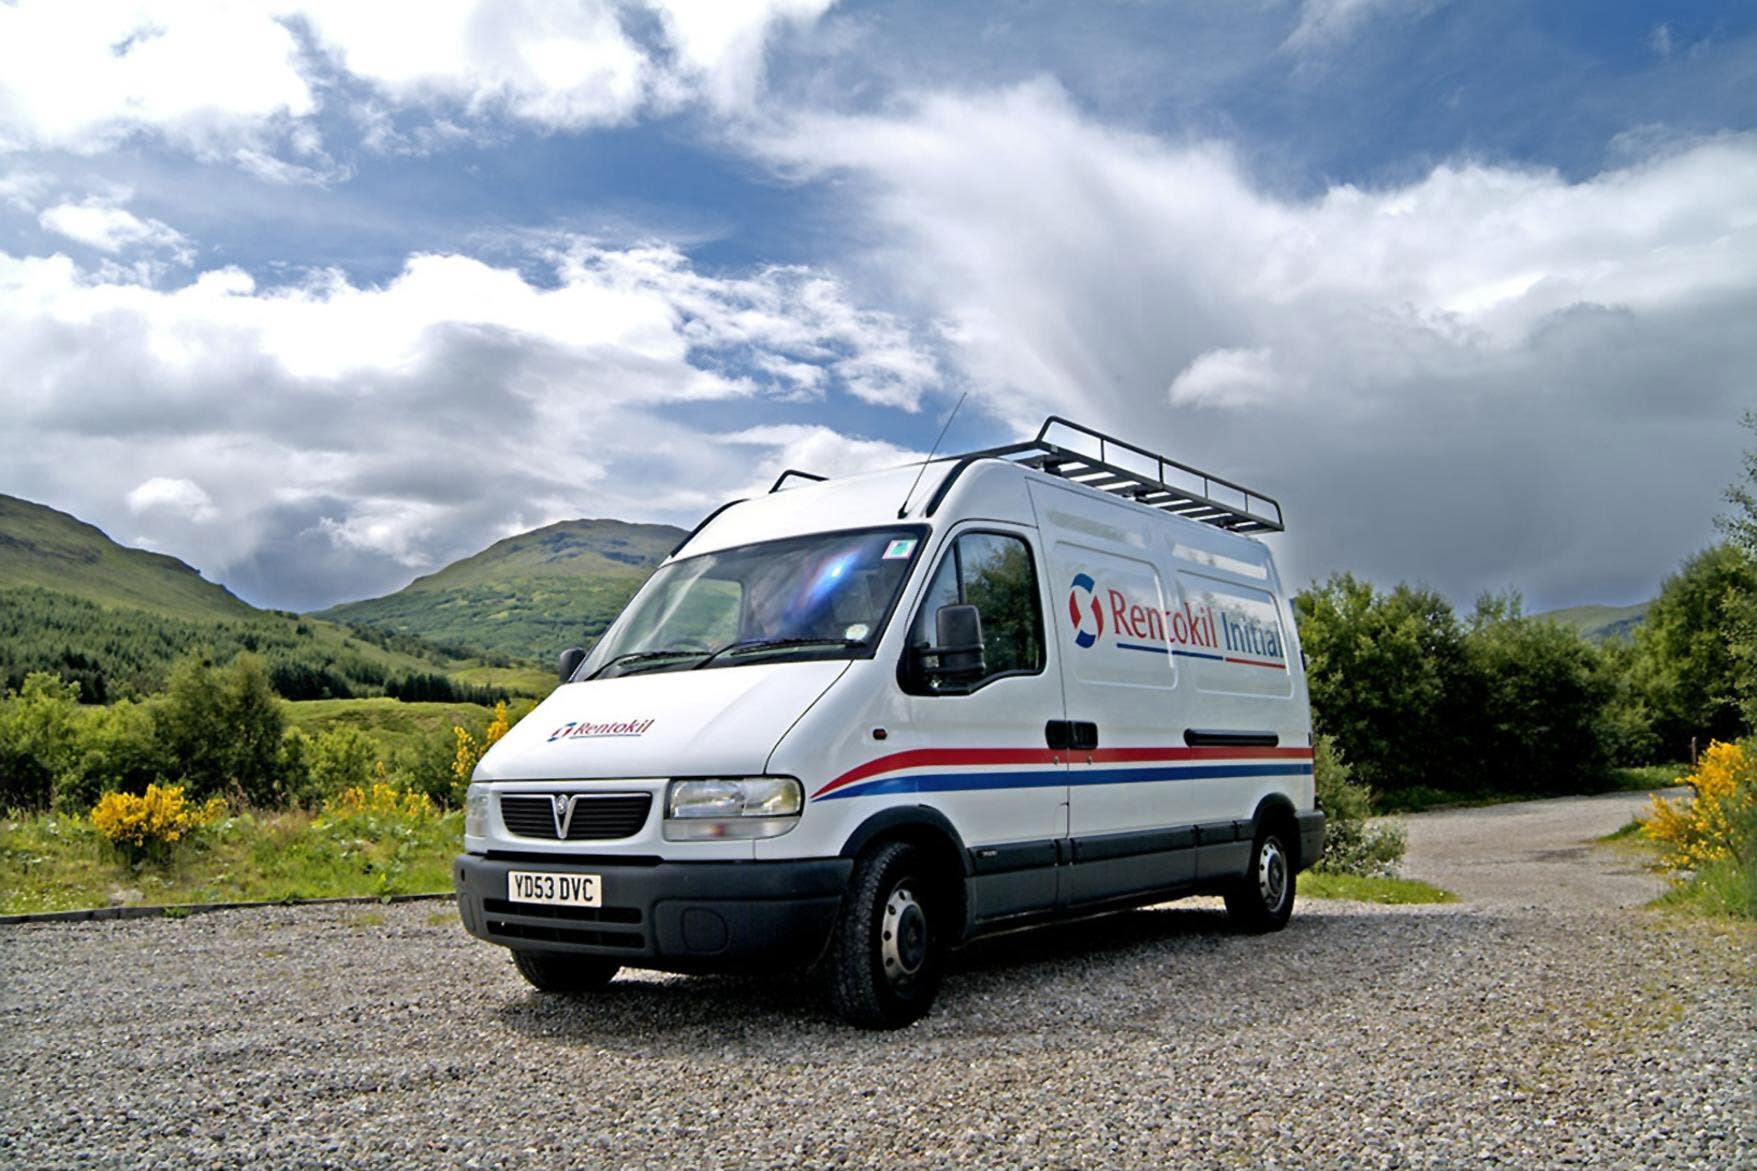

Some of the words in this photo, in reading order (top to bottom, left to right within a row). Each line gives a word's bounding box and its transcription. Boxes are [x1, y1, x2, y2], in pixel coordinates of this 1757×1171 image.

[1221, 611, 1284, 658] Initial
[573, 718, 655, 735] Rentokil
[514, 874, 555, 899] YD53
[559, 876, 594, 902] DVC
